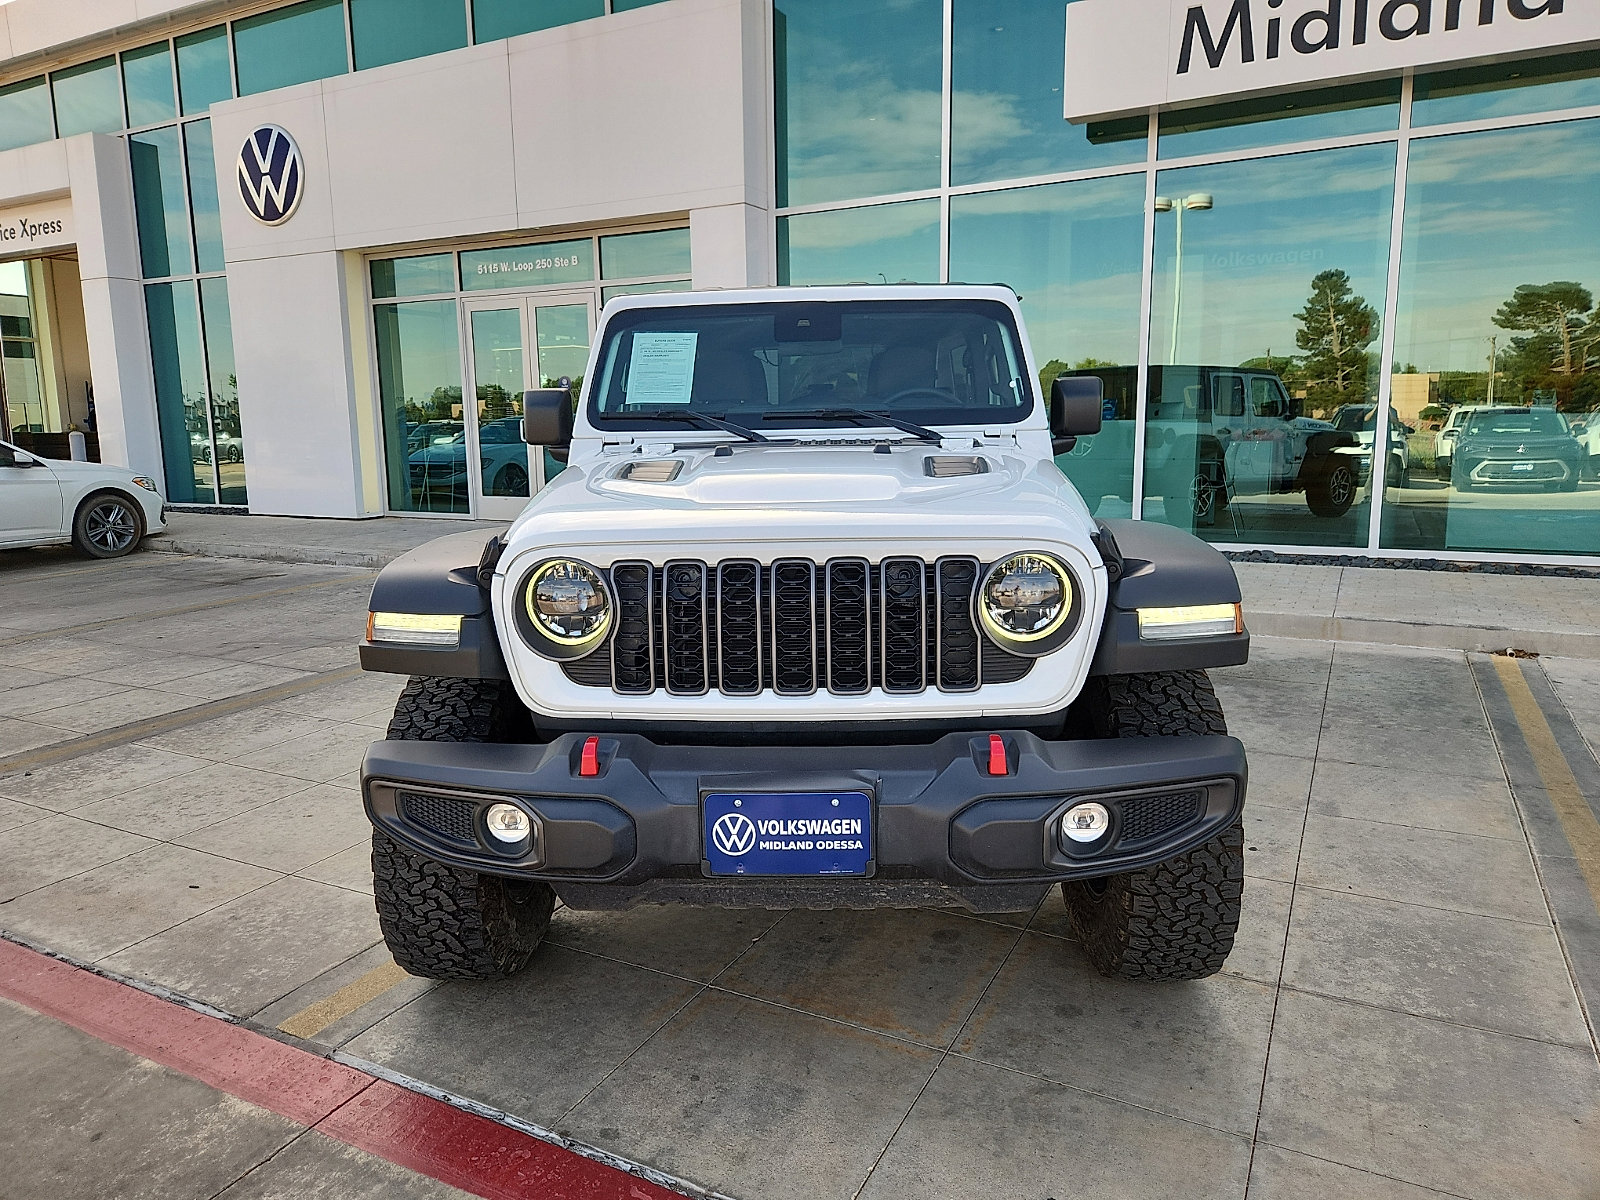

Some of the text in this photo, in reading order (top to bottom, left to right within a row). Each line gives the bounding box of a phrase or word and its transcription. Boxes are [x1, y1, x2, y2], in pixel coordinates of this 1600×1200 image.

[1176, 0, 1564, 74] Midlan
[19, 218, 62, 241] Xpress
[477, 255, 578, 275] 5115 W. Loop 250 Ste B
[712, 813, 862, 856] VW VOLKSWAGEN
[759, 840, 863, 850] MIDLAND ODESSA
